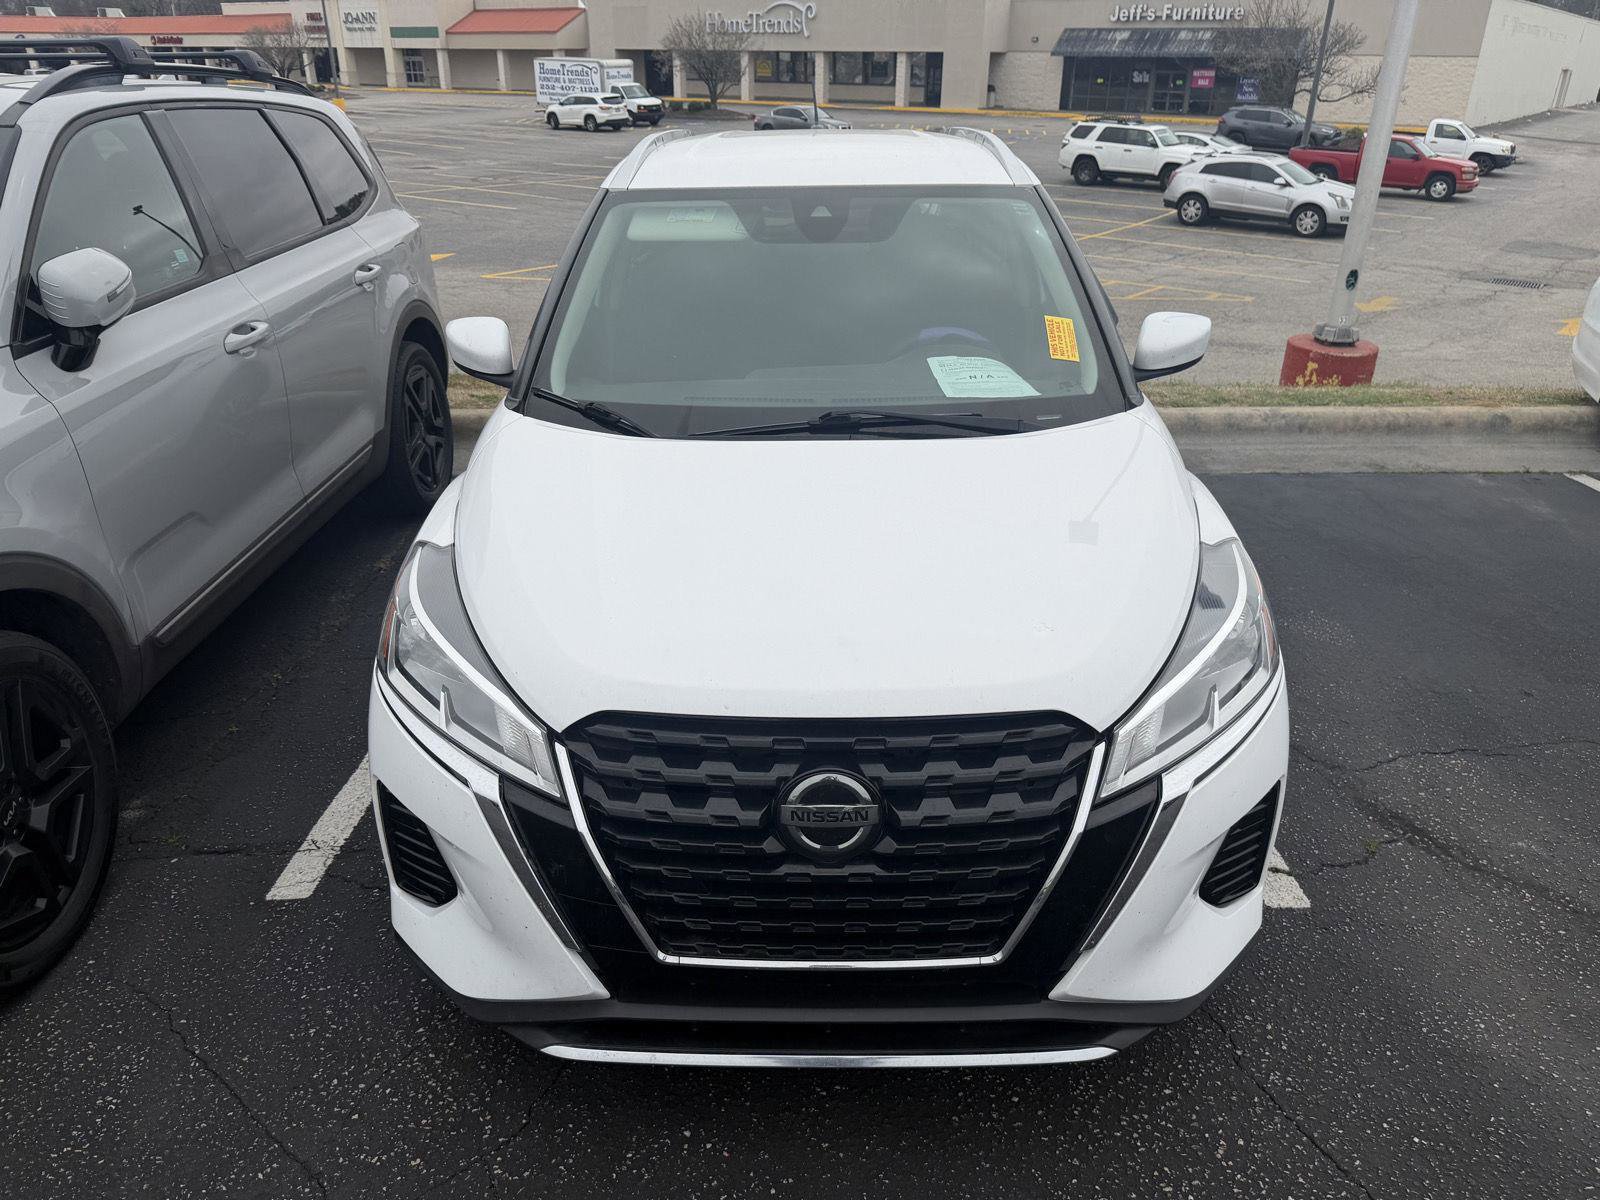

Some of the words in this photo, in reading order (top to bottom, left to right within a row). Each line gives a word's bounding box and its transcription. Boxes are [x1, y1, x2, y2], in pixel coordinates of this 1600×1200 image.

[1110, 4, 1155, 21] Jeff's
[1162, 3, 1245, 20] Furniture
[705, 10, 802, 34] HomeTrends
[538, 62, 591, 78] HomeTrends
[1046, 318, 1057, 343] VEHICLE
[1054, 320, 1062, 334] SALE
[1050, 343, 1059, 356] THIS
[1058, 345, 1066, 357] NOT
[790, 810, 869, 823] NISSAN
